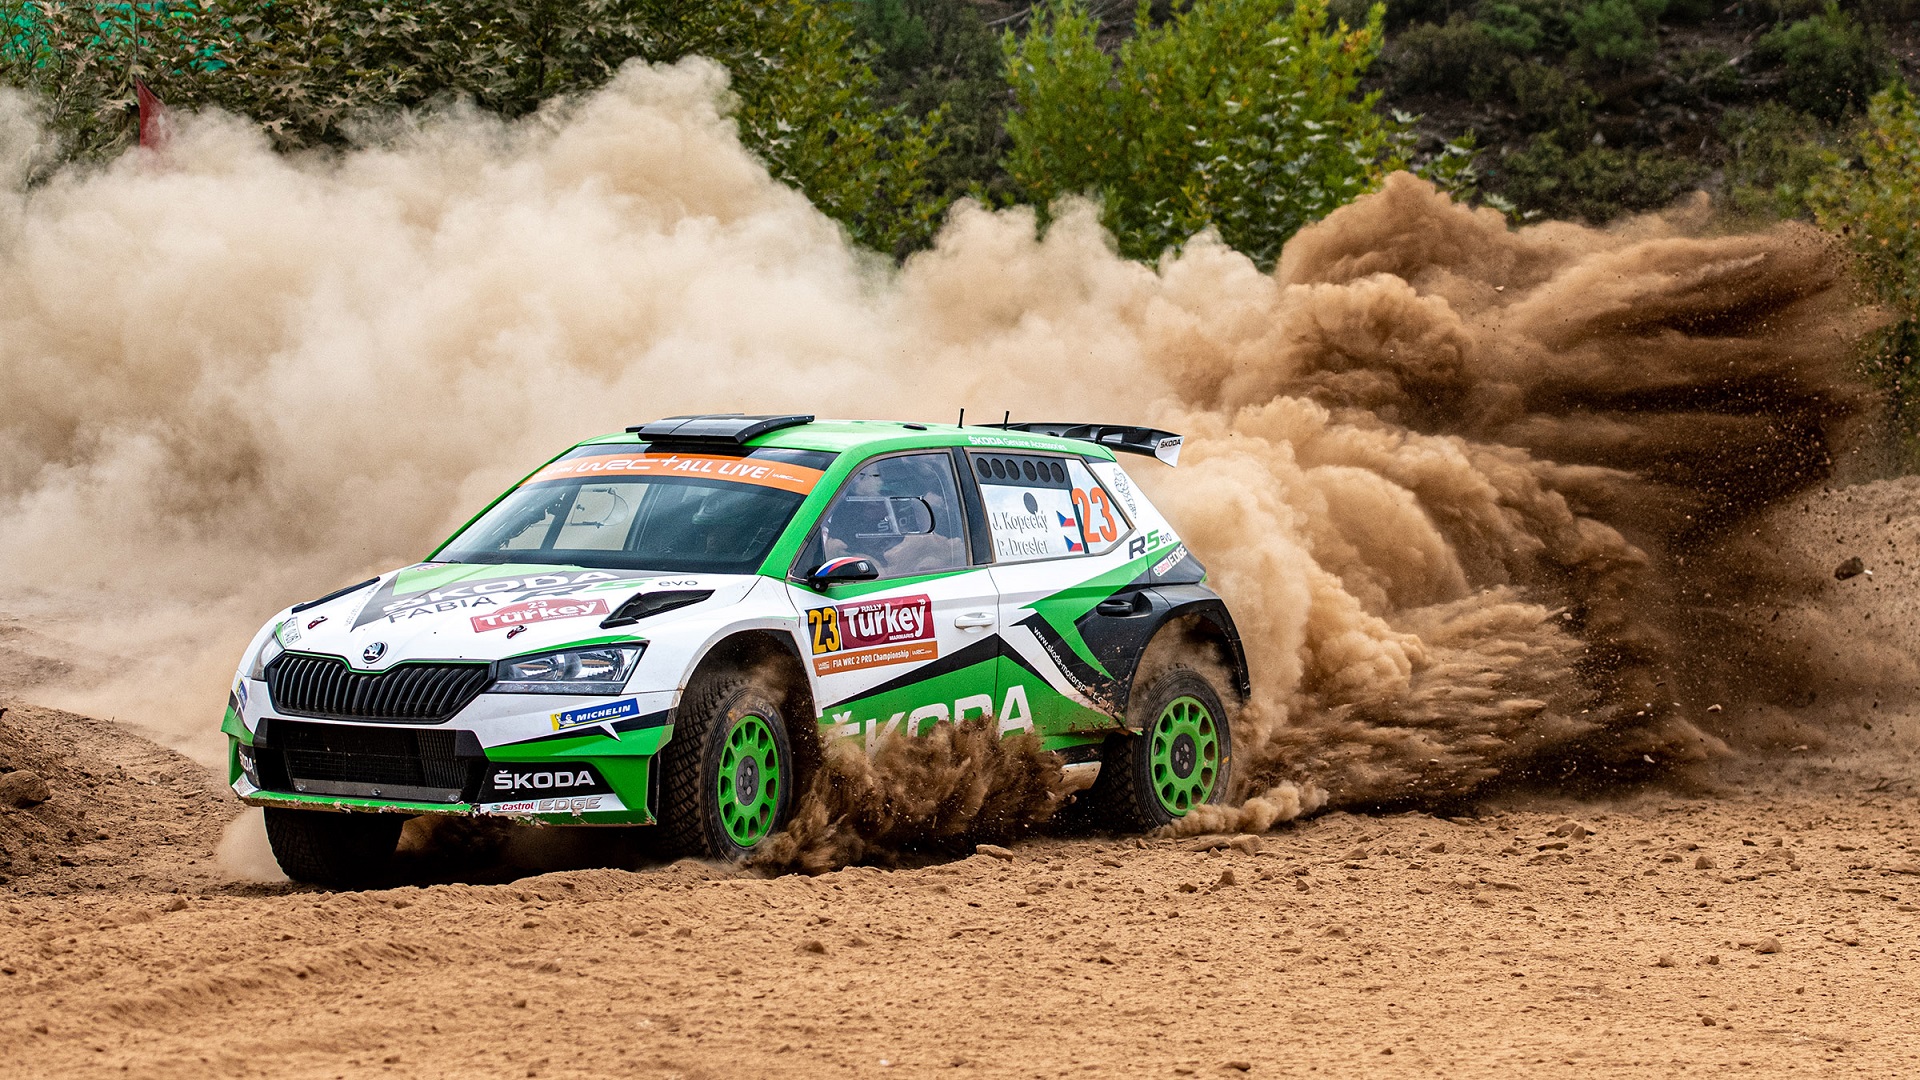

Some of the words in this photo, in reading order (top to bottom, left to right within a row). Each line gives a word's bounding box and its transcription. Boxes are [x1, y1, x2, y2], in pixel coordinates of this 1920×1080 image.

[672, 459, 714, 474] ALL
[717, 462, 769, 480] LIVE
[1071, 486, 1118, 543] 23
[996, 538, 1009, 557] P.
[1008, 537, 1049, 556] Dresler
[1167, 543, 1189, 567] EDGE
[388, 596, 498, 624] FABIA
[479, 601, 598, 627] Turkey
[526, 601, 548, 610] 23
[860, 603, 882, 613] RALLY
[808, 606, 841, 656] 23
[842, 602, 927, 639] Turkey
[832, 658, 843, 669] FIA
[843, 656, 856, 667] WRC
[860, 654, 872, 664] PRO
[872, 649, 910, 662] Championship
[575, 704, 632, 722] MICHELIN
[493, 769, 596, 790] ŠKODA
[501, 801, 535, 811] Castrol
[538, 796, 603, 811] EDGE
